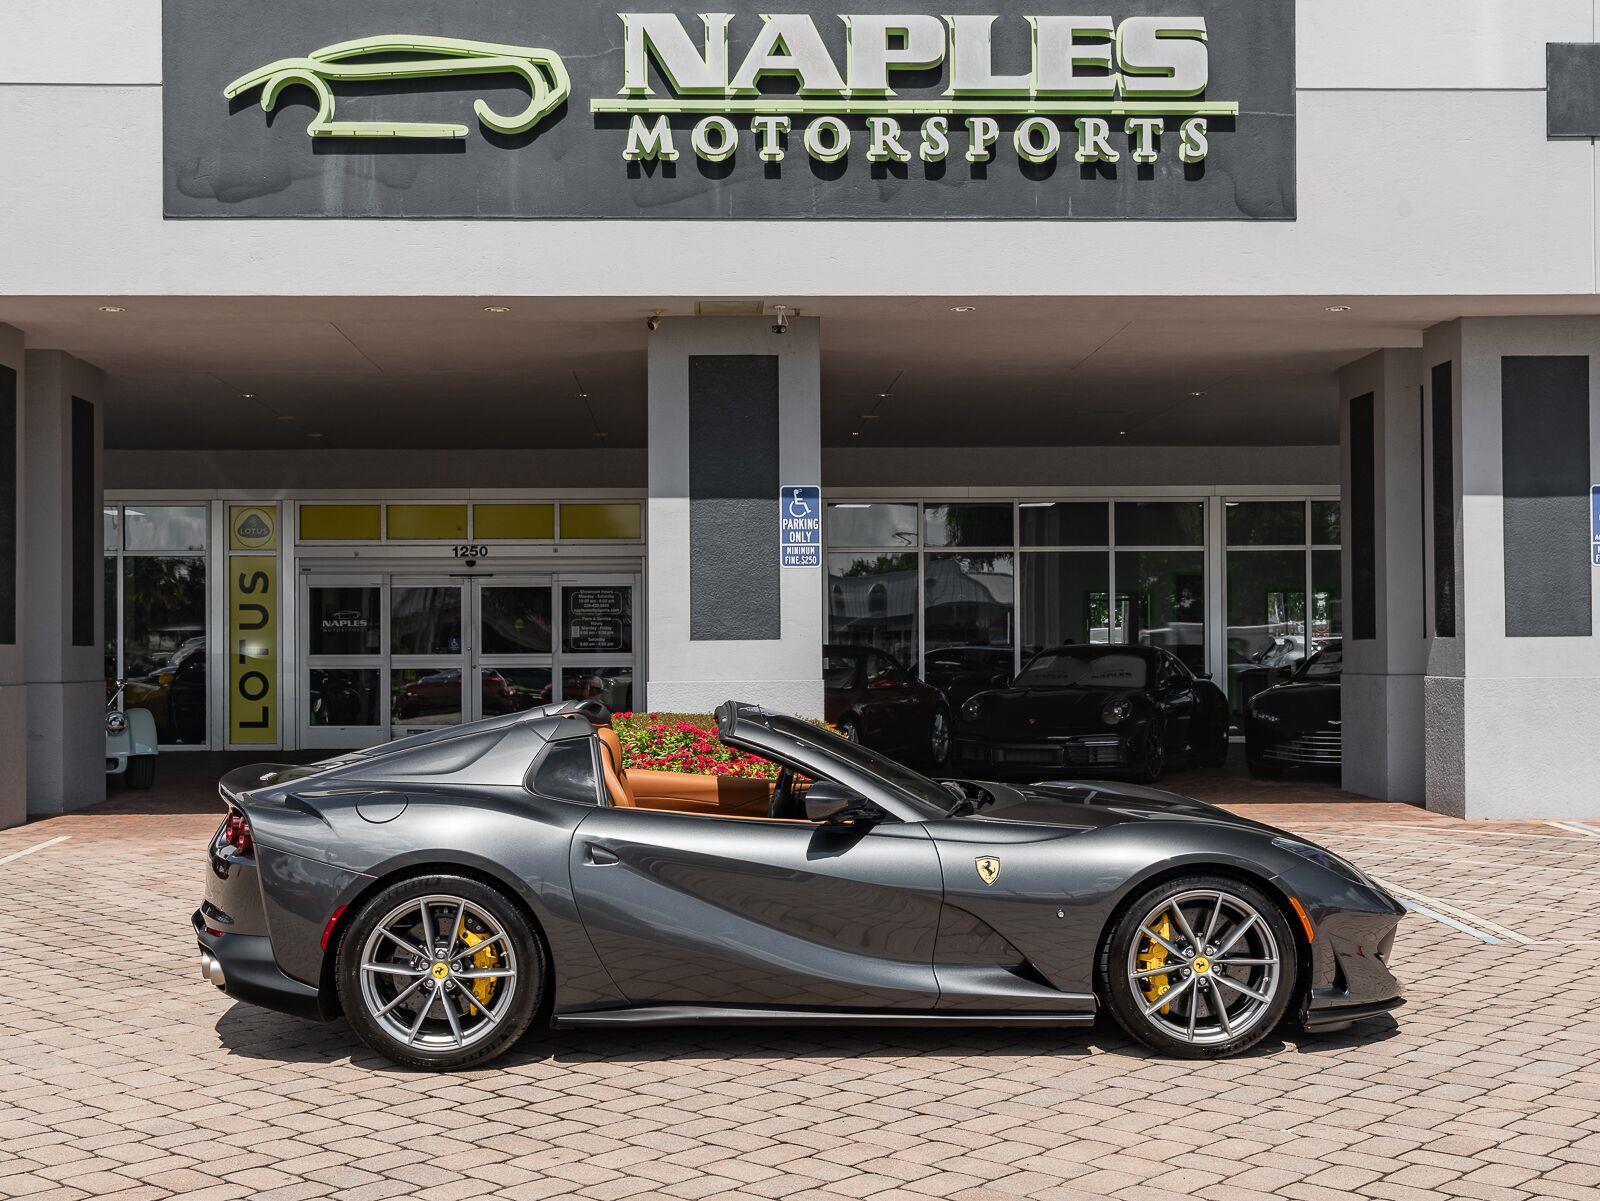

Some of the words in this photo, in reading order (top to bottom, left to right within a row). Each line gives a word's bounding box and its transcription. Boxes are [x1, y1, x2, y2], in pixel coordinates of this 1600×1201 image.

[616, 12, 1208, 97] NAPLES
[622, 114, 1208, 163] MOTORSPORTS
[782, 518, 819, 530] PARKING
[240, 527, 268, 535] LOTUS
[789, 531, 812, 543] ONLY
[452, 545, 488, 557] 1250
[786, 546, 815, 555] MINIMUM
[801, 556, 817, 566] $250
[322, 619, 368, 627] NAPLES
[239, 571, 269, 728] LOTUS
